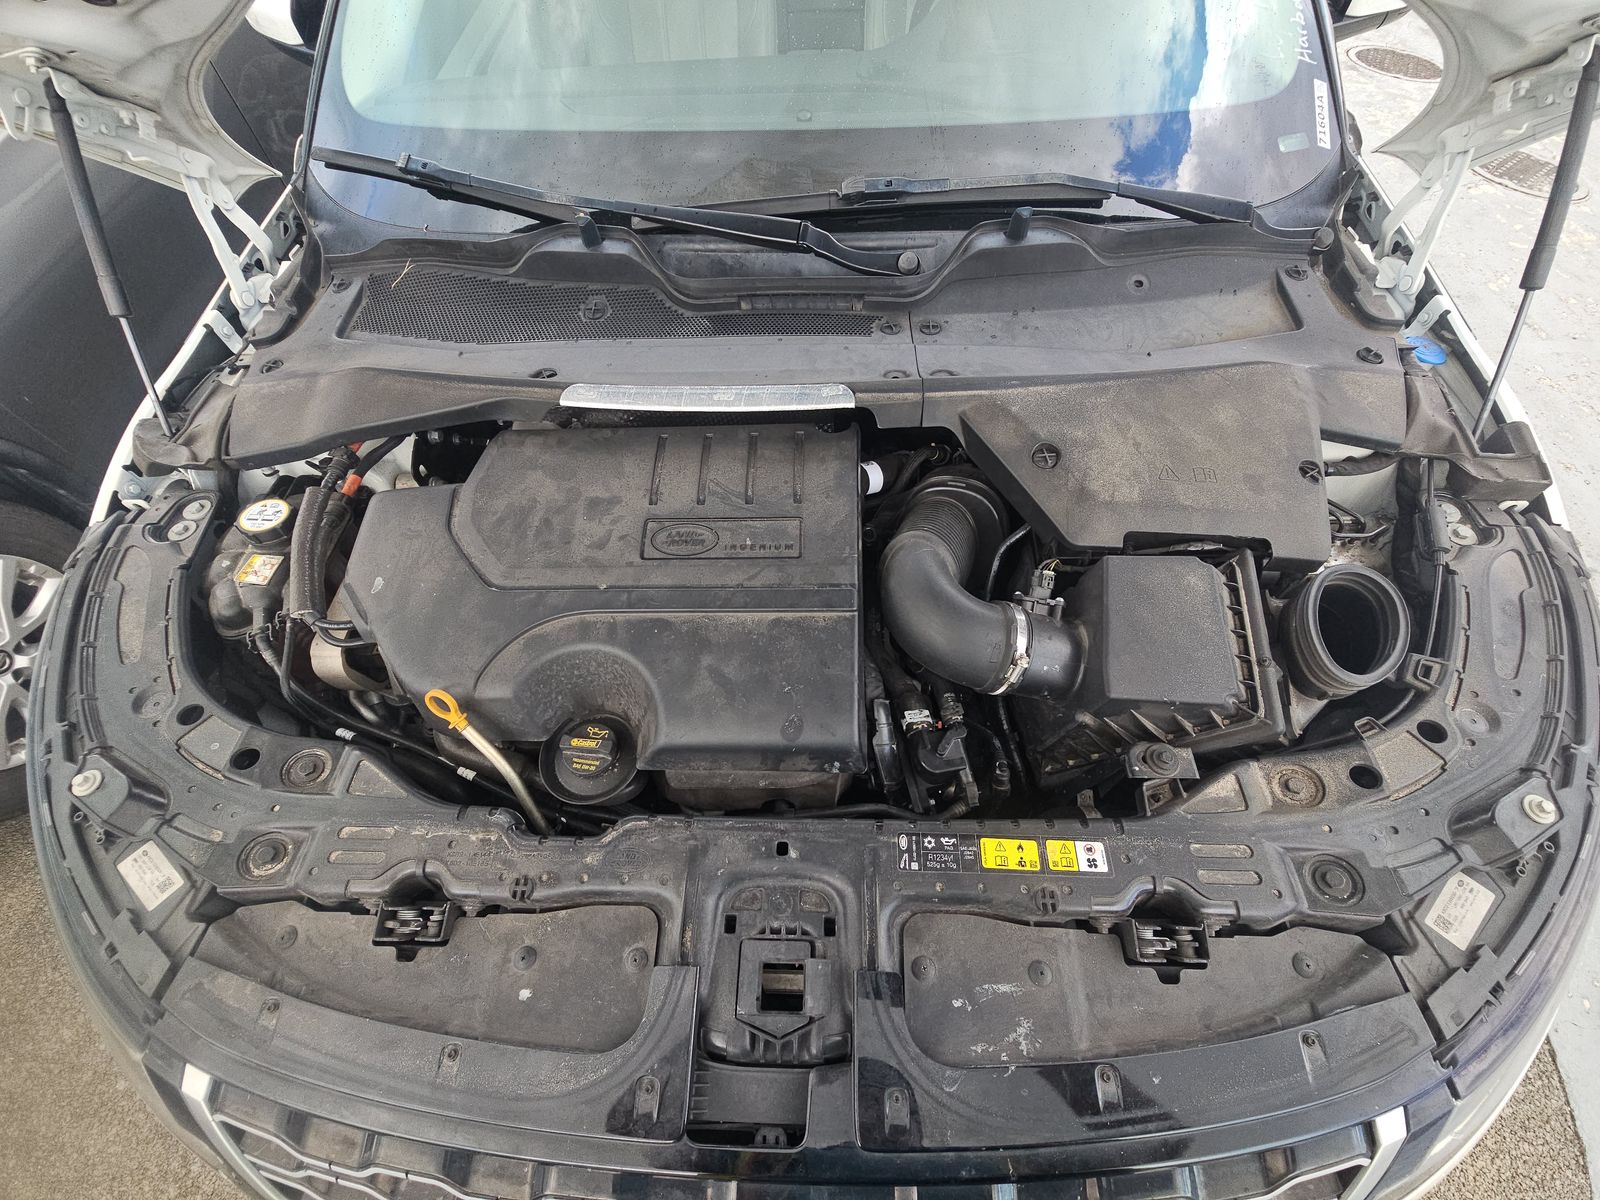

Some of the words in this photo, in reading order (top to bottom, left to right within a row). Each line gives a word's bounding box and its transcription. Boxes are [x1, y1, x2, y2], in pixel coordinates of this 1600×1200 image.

[1316, 95, 1328, 145] 71604A
[724, 543, 794, 551] INGENIUM
[928, 853, 954, 862] R1234yf
